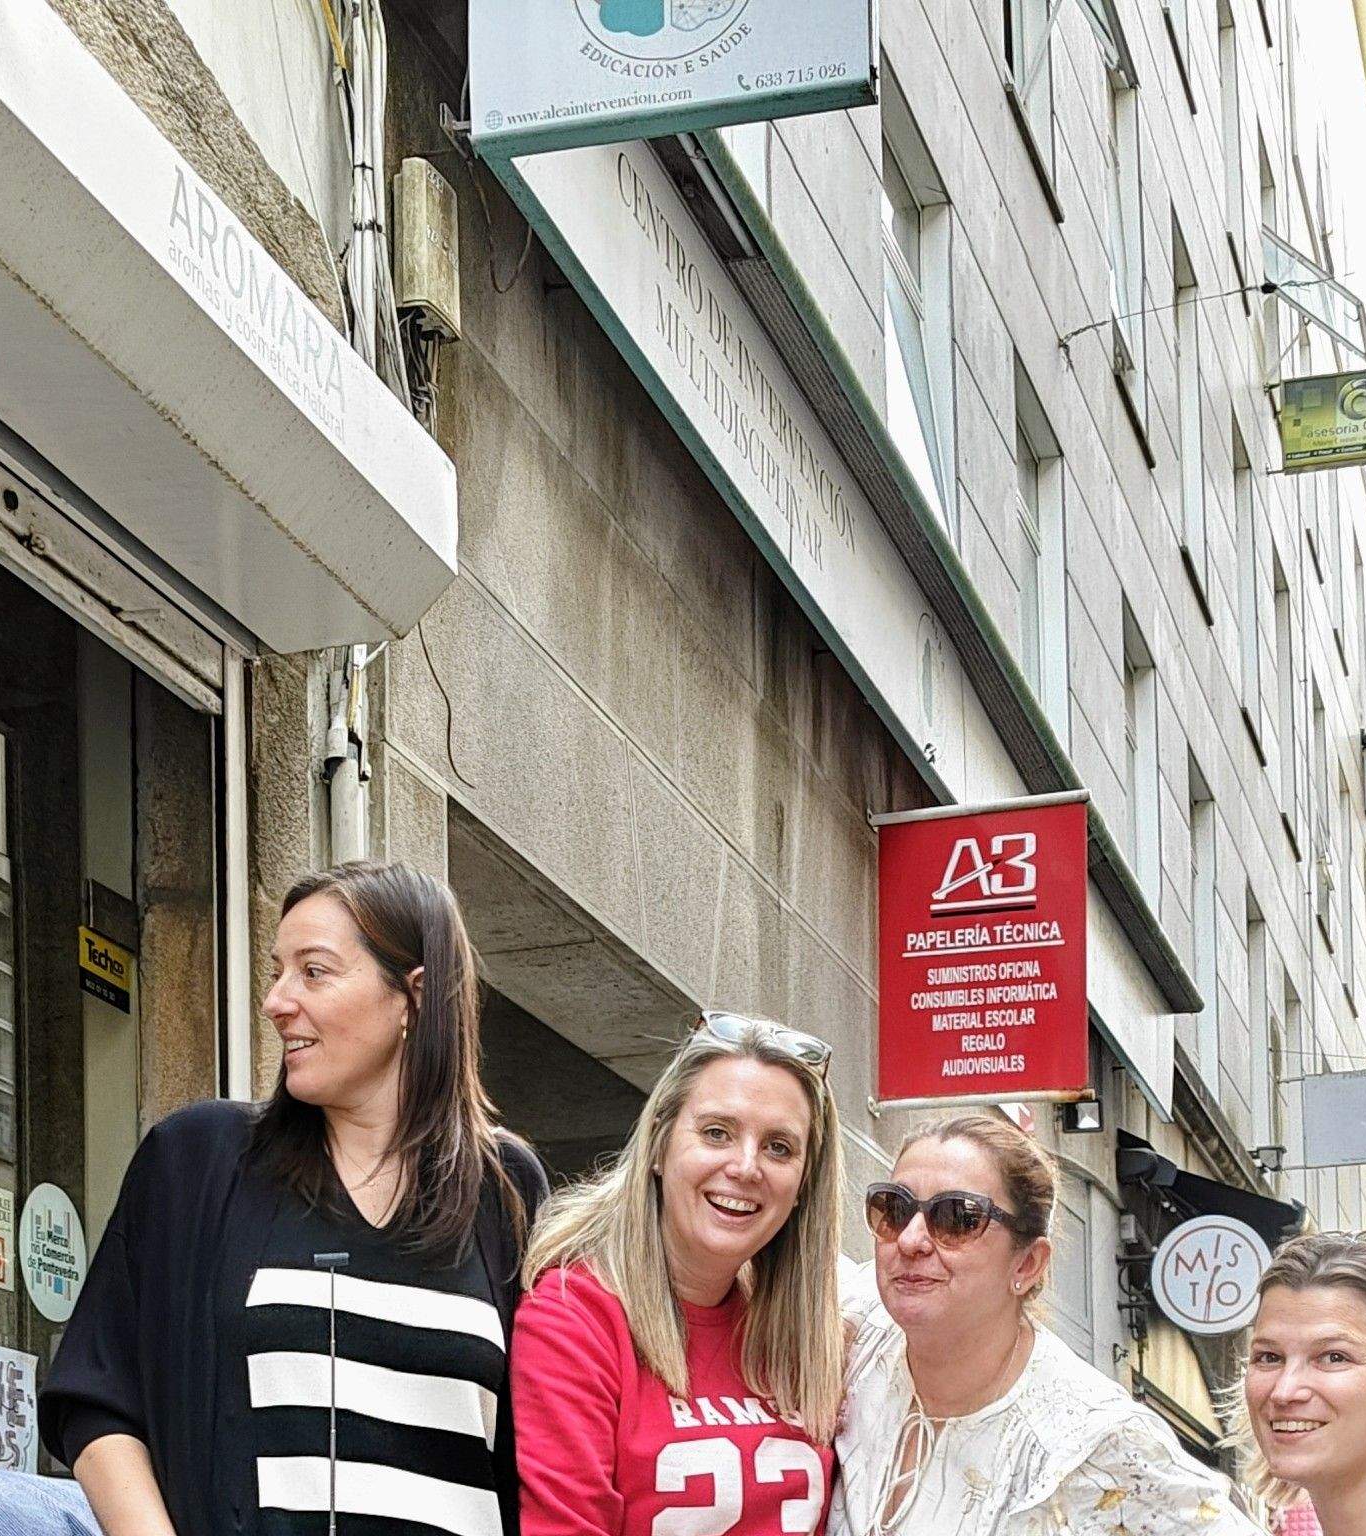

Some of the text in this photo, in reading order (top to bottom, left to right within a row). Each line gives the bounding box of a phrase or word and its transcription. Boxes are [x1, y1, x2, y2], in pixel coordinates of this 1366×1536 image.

[579, 22, 753, 78] EDUCACIÓN E SAÚDE
[755, 62, 847, 89] 633 715 026
[169, 164, 346, 414] AROMARA
[169, 238, 346, 446] aromas y cosmética natural
[617, 152, 856, 555] CENTRO DE INTERVENCIÓN
[656, 283, 824, 571] MULTIDISCIPLINAR
[932, 832, 1037, 900] A3
[907, 920, 1061, 951] PAPELERÍA TÉCNICA
[927, 960, 1041, 985] SUMINISTROS OFICINA
[911, 981, 1058, 1010] CONSUMIBLES INFORMÁTICA
[932, 1008, 1036, 1032] MATERIAL ESCOLAR
[961, 1032, 1006, 1052] REGALO
[941, 1055, 1025, 1077] AUDIOVISUALES
[42, 1243, 75, 1265] Comercio
[37, 1257, 79, 1281] Pontevedra
